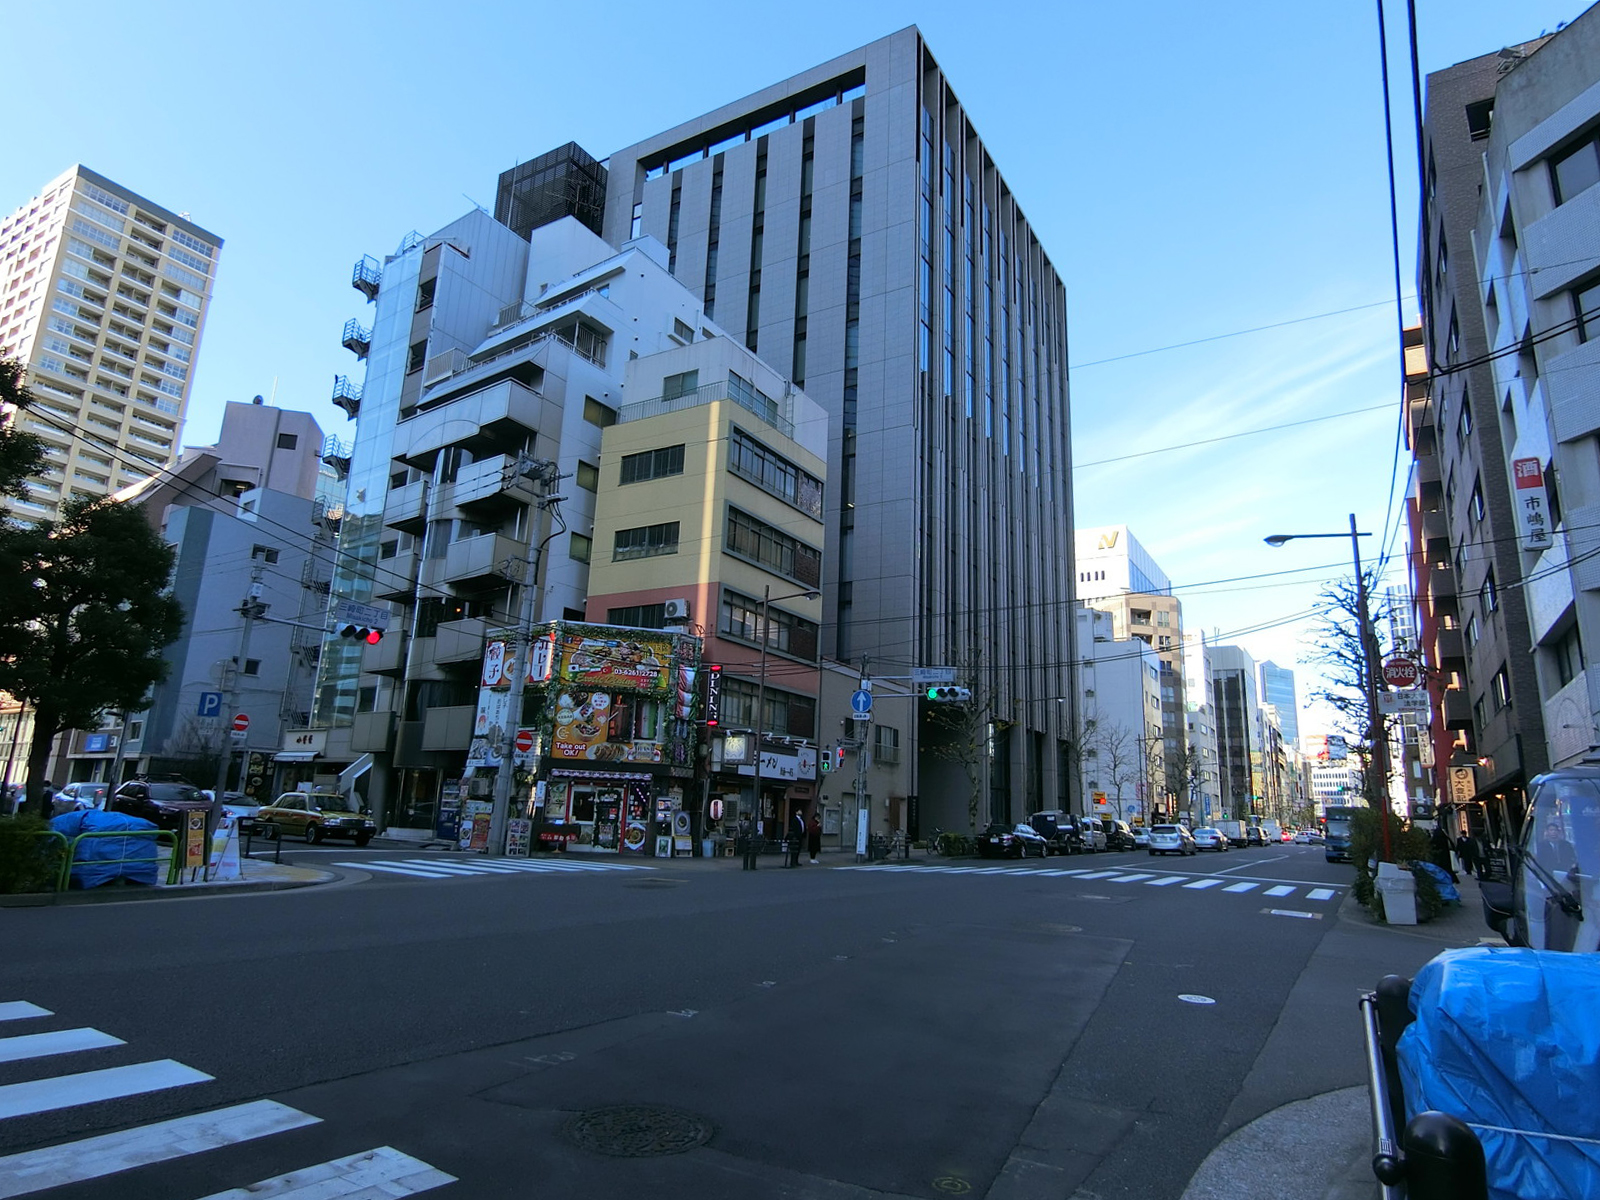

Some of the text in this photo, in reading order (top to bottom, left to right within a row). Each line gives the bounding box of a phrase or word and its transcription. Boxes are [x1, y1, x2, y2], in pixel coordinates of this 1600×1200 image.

[1515, 460, 1539, 478] 酒
[338, 602, 389, 620] 三崎町二丁目
[488, 645, 501, 680] 餃子
[1385, 666, 1415, 679] 消火栓
[203, 694, 218, 715] P
[556, 742, 573, 750] Take
